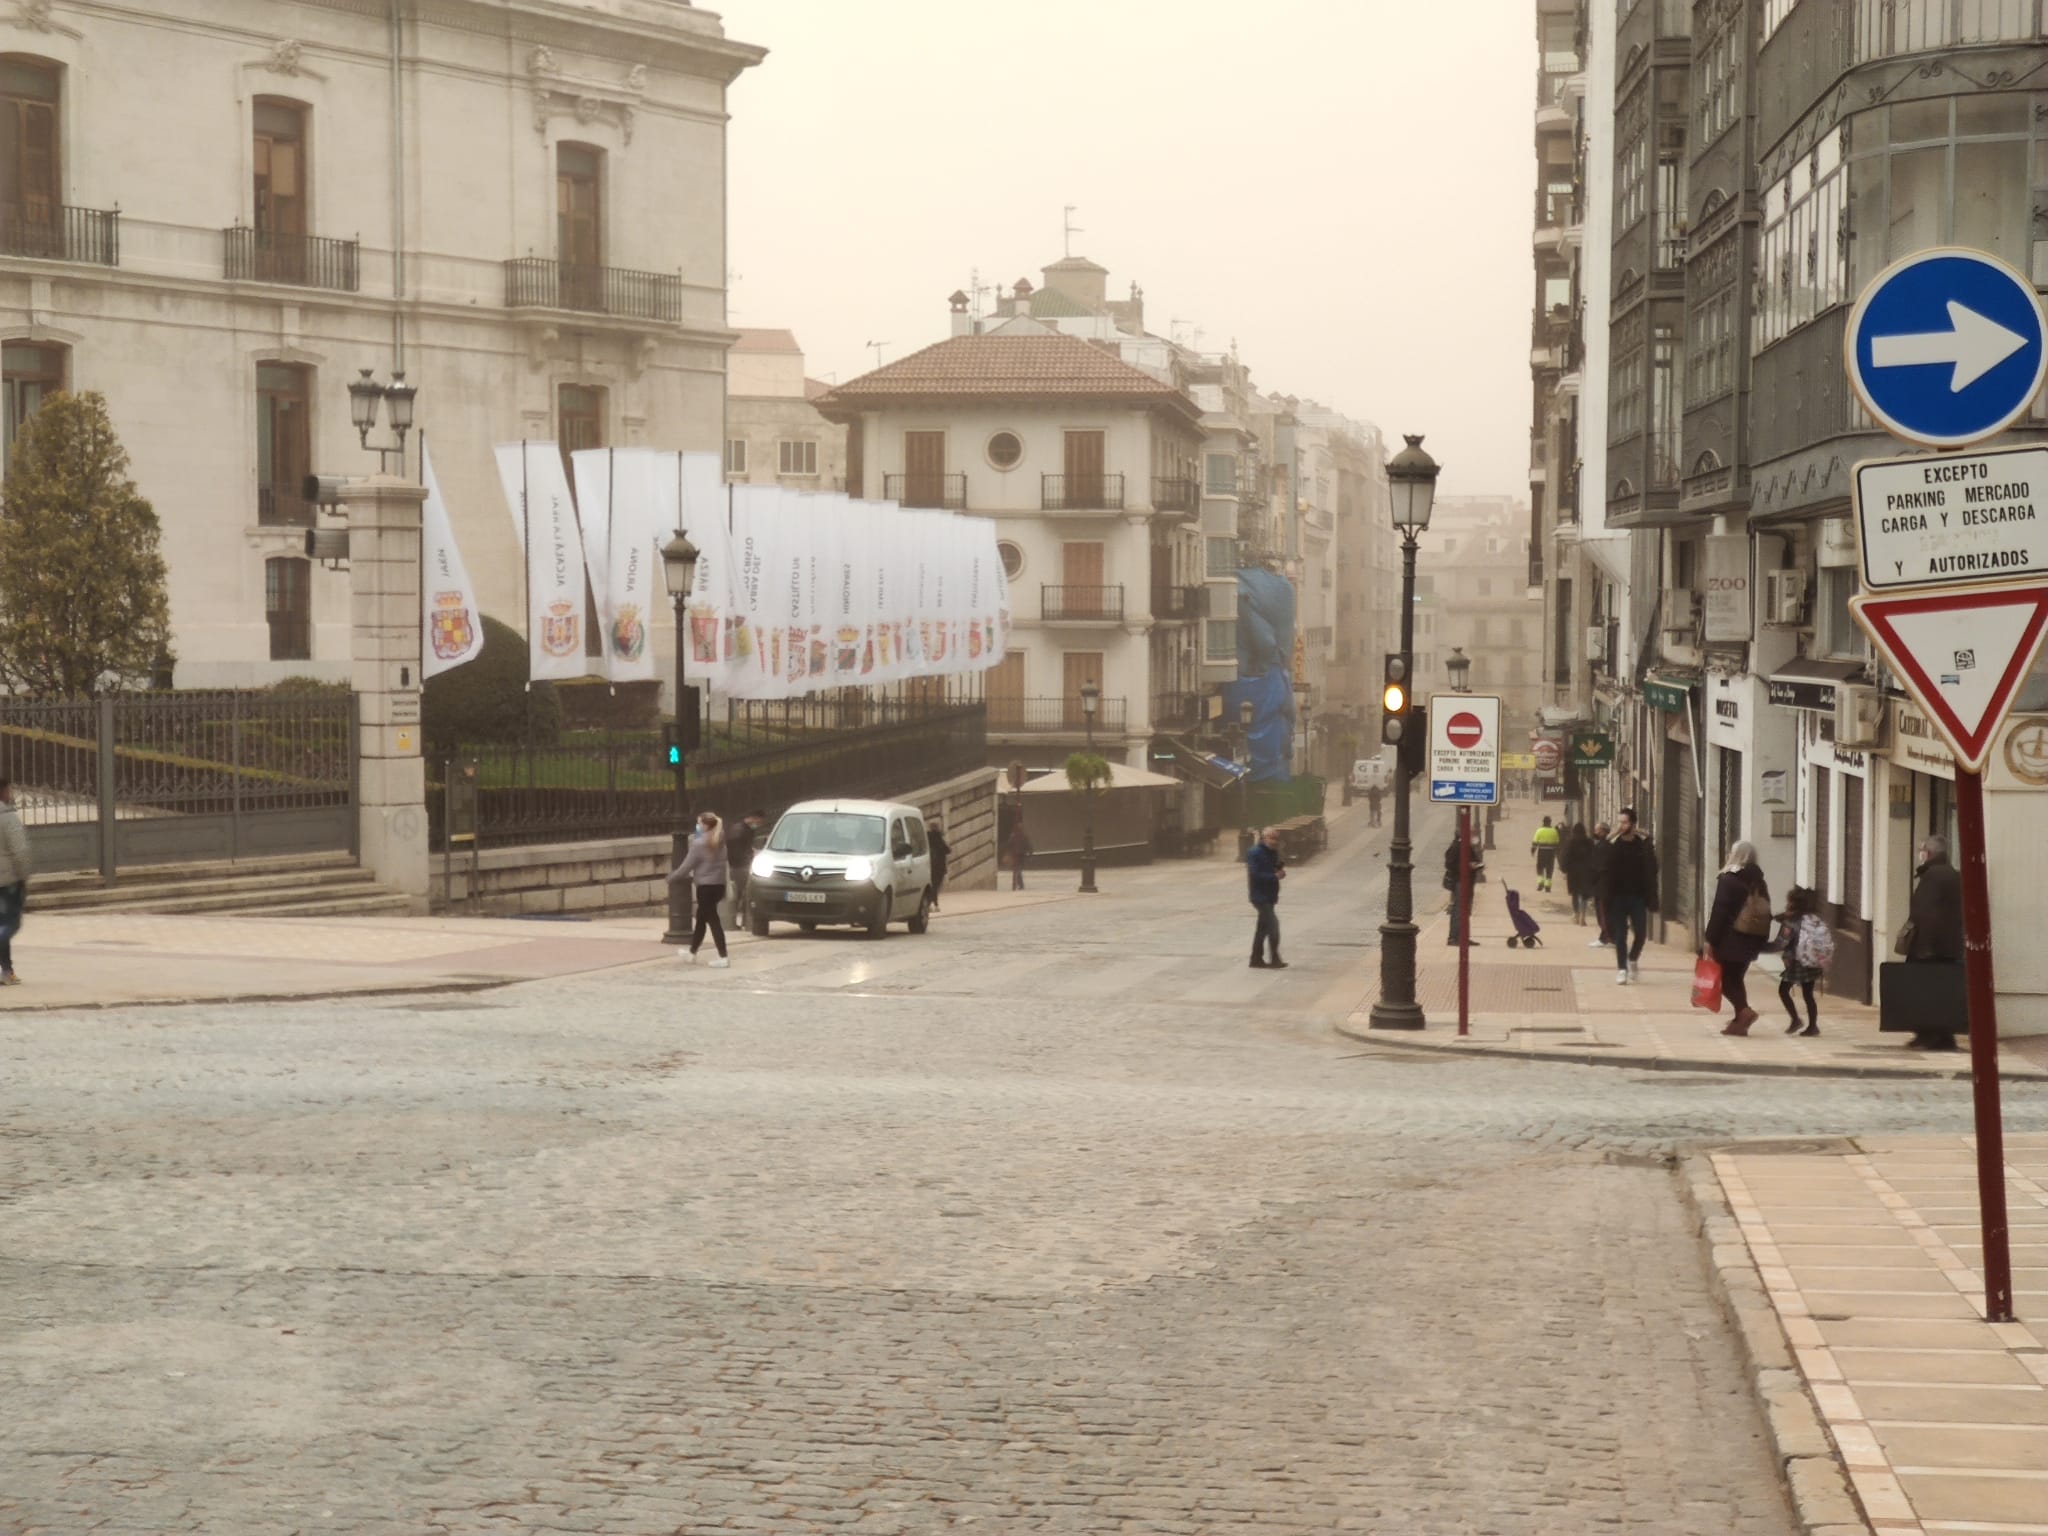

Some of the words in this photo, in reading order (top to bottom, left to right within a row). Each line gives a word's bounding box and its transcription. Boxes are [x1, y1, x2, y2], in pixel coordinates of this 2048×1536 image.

[1924, 463, 1988, 484] EXCEPTO
[1887, 490, 1945, 511] PARKING
[1965, 482, 2030, 503] MERCADO
[1881, 514, 1928, 534] CARGA
[1940, 512, 1949, 527] Y
[1962, 504, 2036, 526] DESCARGA
[1895, 561, 1903, 577] Y
[1929, 549, 2029, 574] AUTORIZADOS
[1708, 577, 1746, 591] ZOO
